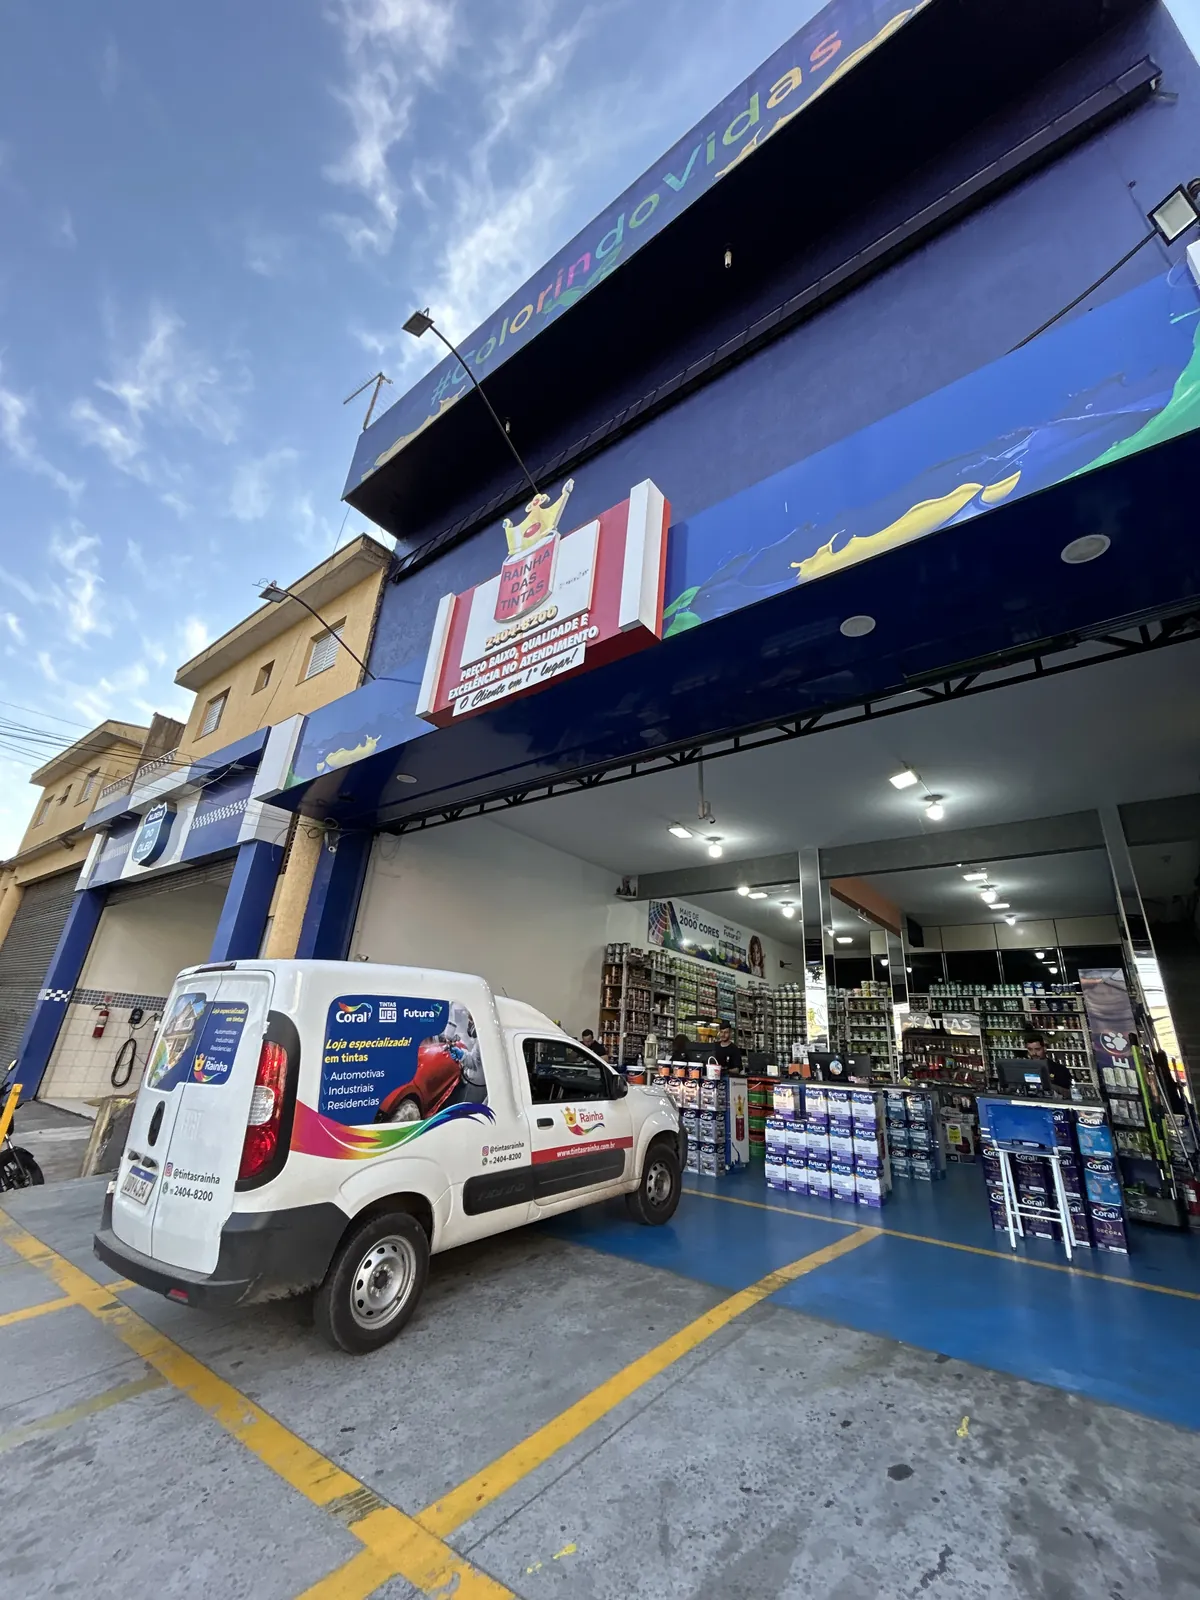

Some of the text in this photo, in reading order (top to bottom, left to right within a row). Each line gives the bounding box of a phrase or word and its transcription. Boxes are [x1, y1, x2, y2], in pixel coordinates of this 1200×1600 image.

[503, 549, 550, 582] RAINHA
[511, 572, 537, 594] DAS
[501, 580, 544, 611] TINTAS
[485, 606, 558, 650] 2404-8200
[460, 614, 589, 681] PREÇO BAIXO, QUALIDADE E
[448, 625, 599, 701] EXCELÊNCIA NO ATENDIMENTO
[460, 696, 469, 710] O
[471, 684, 505, 707] Cliente
[508, 676, 522, 690] em
[540, 648, 579, 678] lugar!
[679, 908, 700, 921] MAIS DE
[679, 915, 698, 930] 2000
[698, 922, 720, 939] CORES
[336, 1011, 368, 1023] Coral
[403, 1009, 435, 1018] Futura
[923, 1015, 972, 1031] ATLAS
[325, 1037, 413, 1051] Loja especializada!
[324, 1053, 369, 1064] em tintas
[204, 1060, 228, 1073] Rainha
[330, 1069, 385, 1081] Automotivas
[328, 1083, 375, 1096] Industriais
[327, 1097, 380, 1111] Residencias
[579, 1110, 604, 1123] Rainha
[1078, 1116, 1101, 1125] Coral
[489, 1141, 525, 1154] @tintasrainha
[556, 1142, 616, 1158] www.tintasrainha.com.br
[983, 1148, 1000, 1157] Cora
[493, 1152, 522, 1165] 2404-8200
[1087, 1161, 1111, 1171] Coral
[173, 1168, 221, 1185] @tintasrainha
[173, 1185, 214, 1202] 2404-8200
[1021, 1197, 1043, 1207] Coral
[1092, 1208, 1116, 1219] Coral
